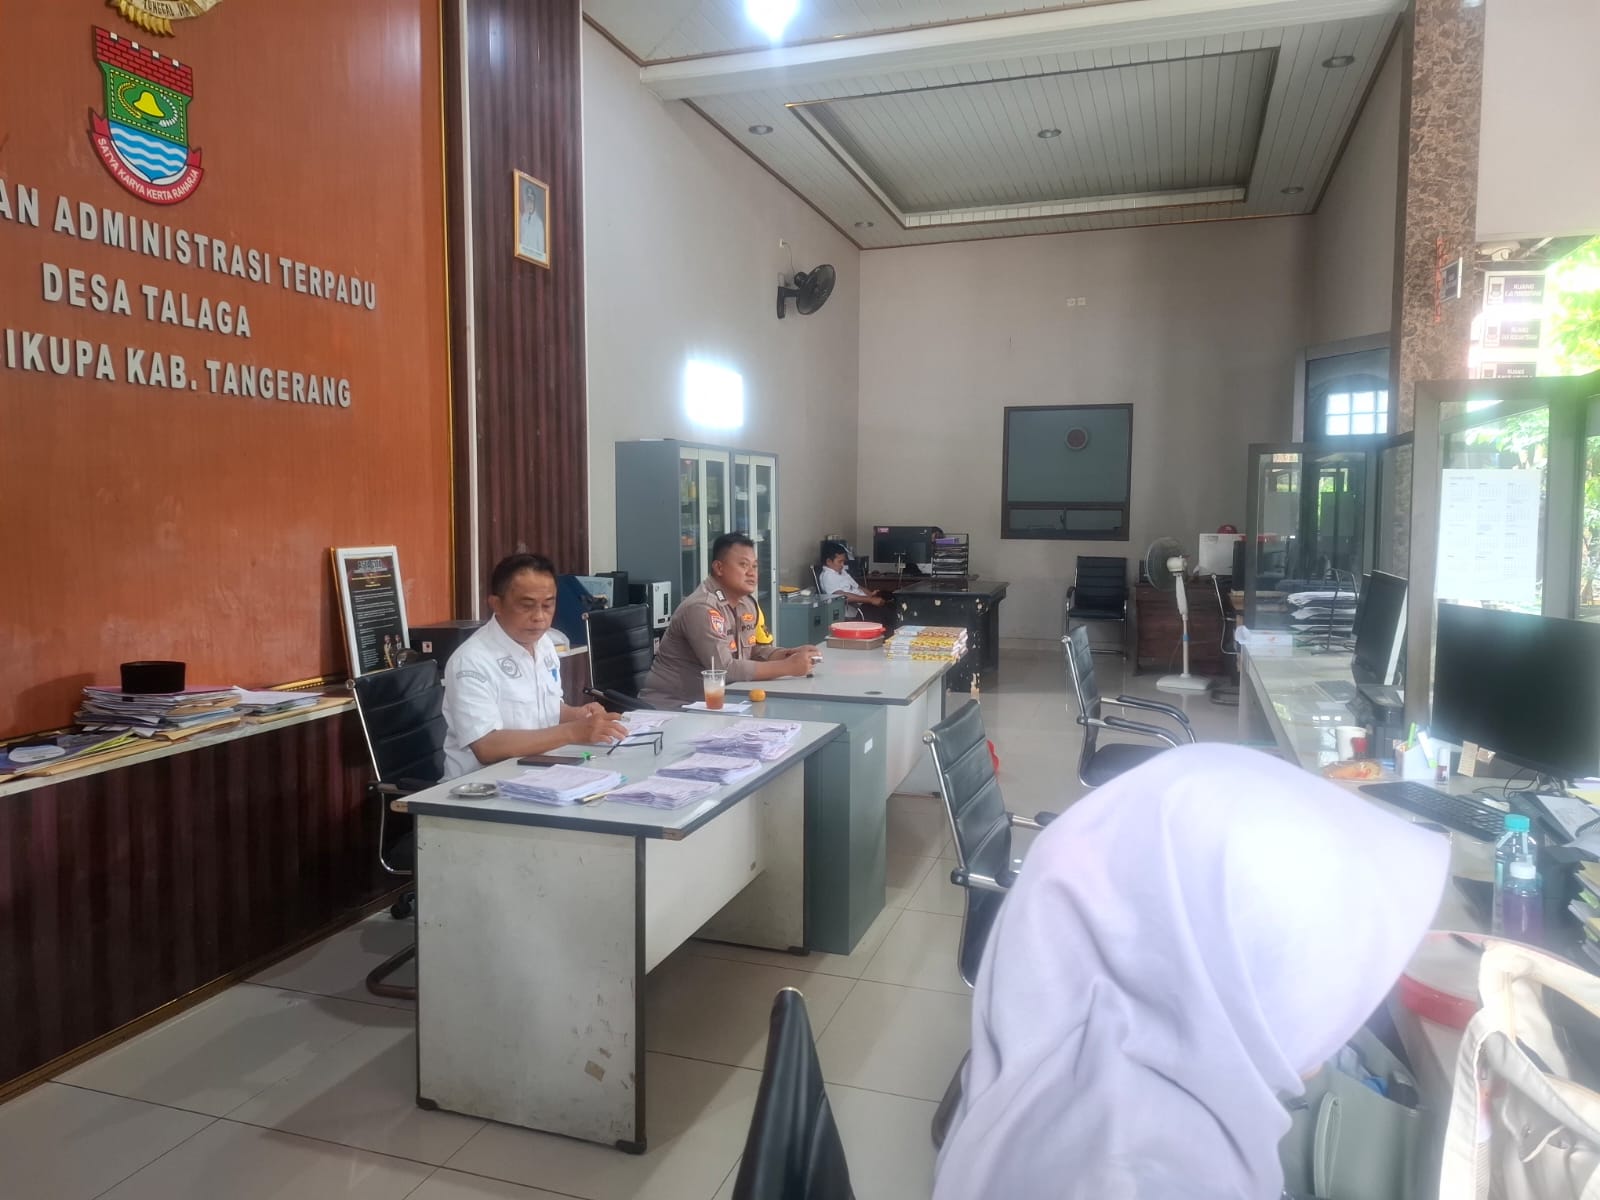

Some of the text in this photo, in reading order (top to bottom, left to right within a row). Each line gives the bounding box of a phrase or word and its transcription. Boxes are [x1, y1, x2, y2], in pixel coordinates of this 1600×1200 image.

[98, 138, 200, 200] SATYA KARYA KERTA RAHARJA
[54, 196, 271, 284] ADMINISTRASI
[279, 257, 377, 310] TERPADU
[43, 263, 251, 337] DESA TALAGA
[7, 329, 351, 408] IKUPA KAB. TANGERANG
